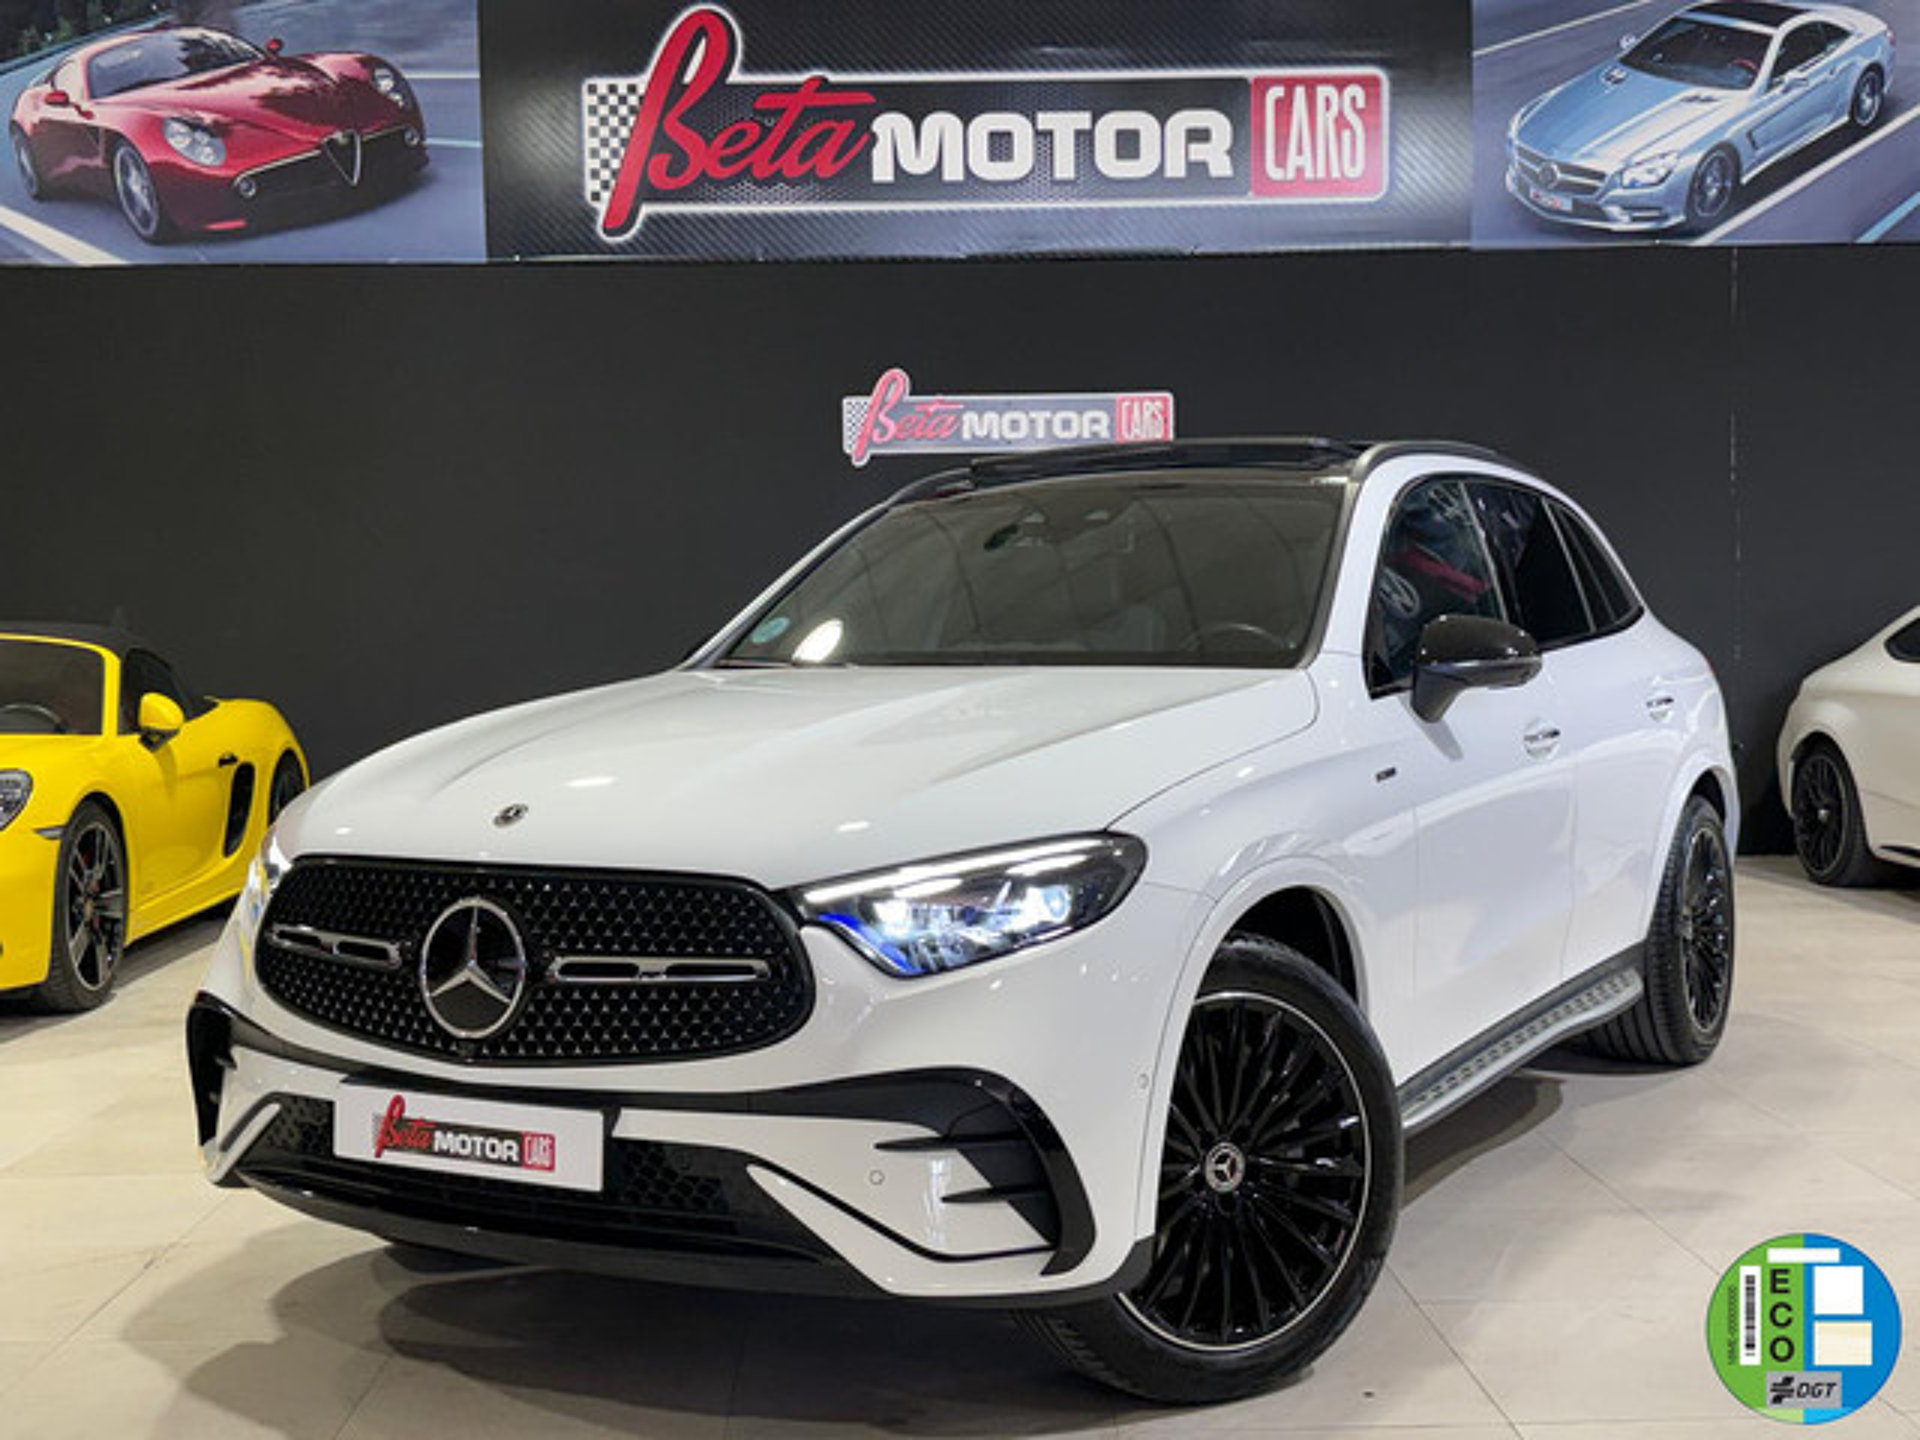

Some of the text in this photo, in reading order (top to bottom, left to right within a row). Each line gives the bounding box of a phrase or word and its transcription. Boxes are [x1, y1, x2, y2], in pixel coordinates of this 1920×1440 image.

[602, 10, 1366, 232] Beta MOTOR CARS
[852, 369, 1165, 464] Beta MOTOR CARS
[374, 1094, 554, 1168] Beta MOTOR CARS
